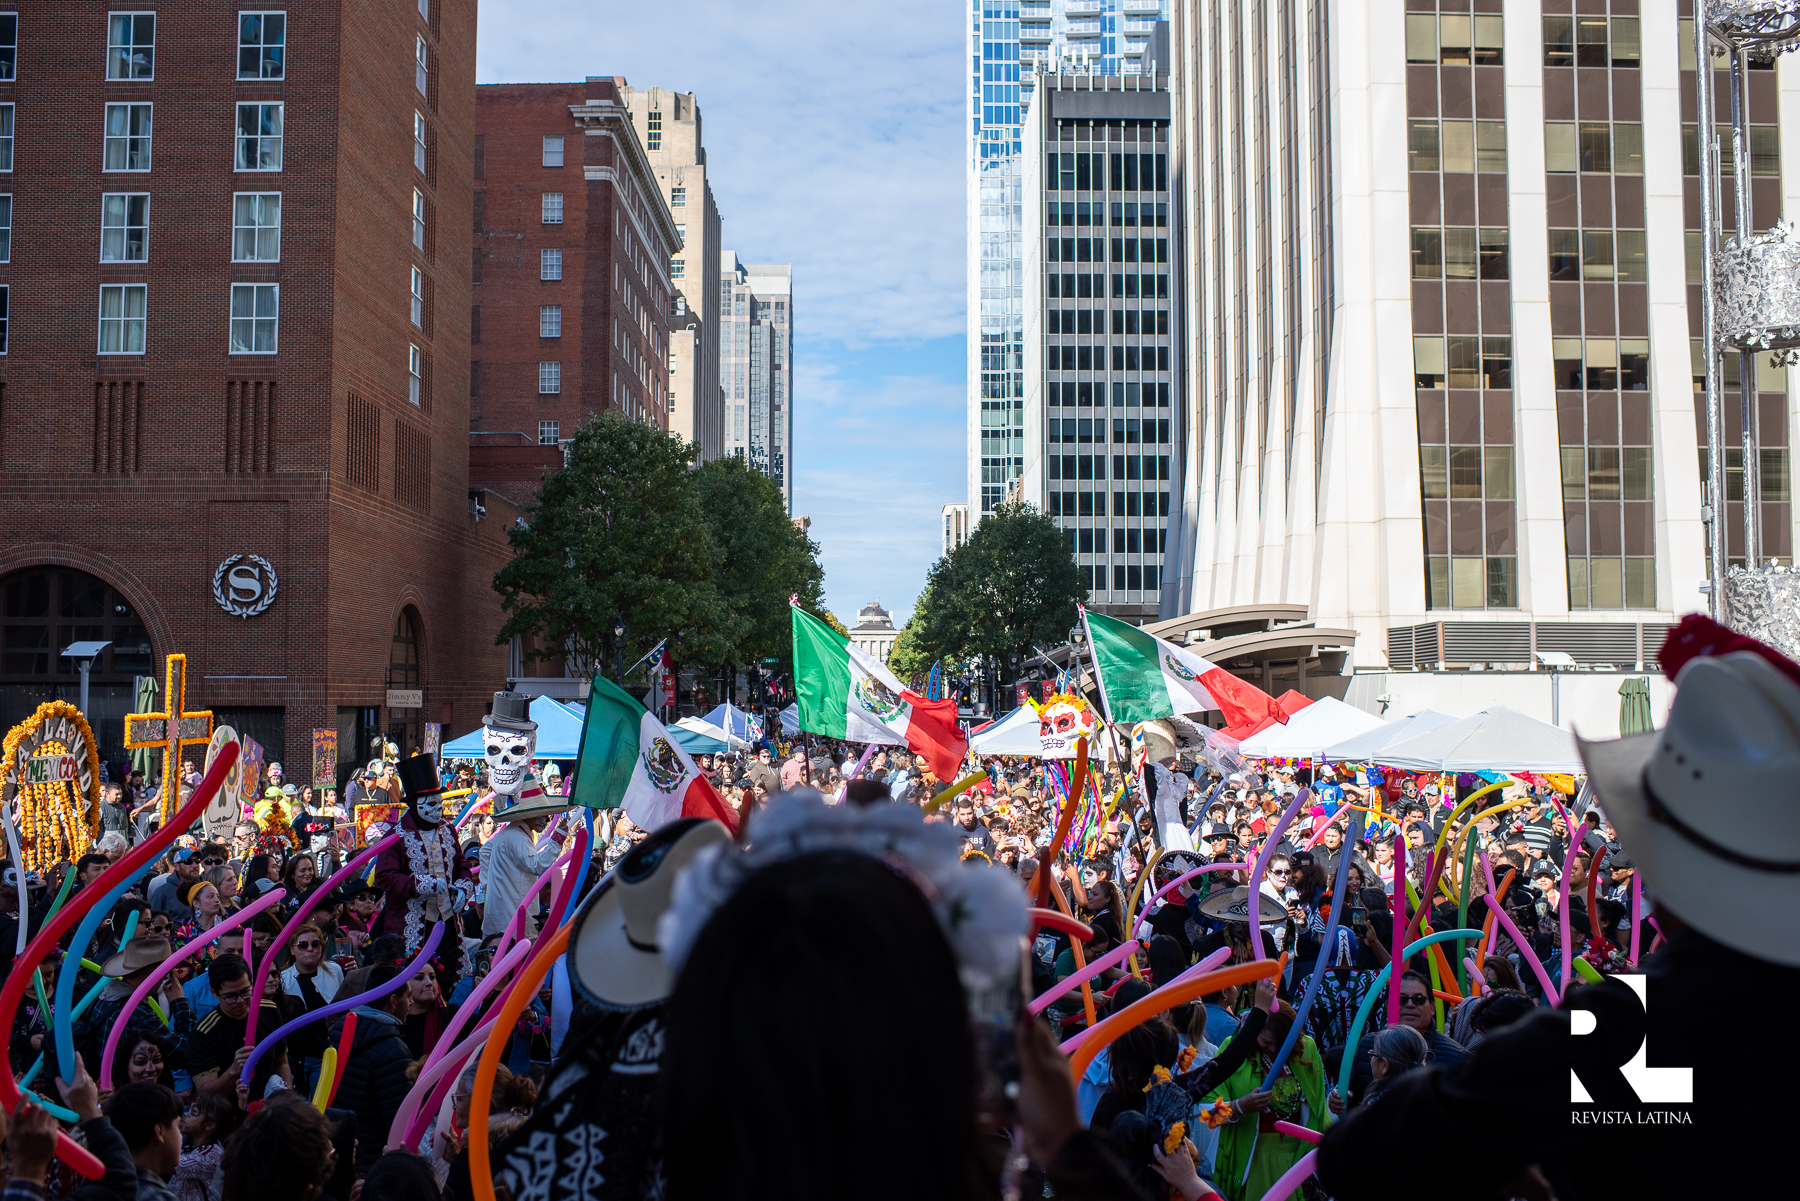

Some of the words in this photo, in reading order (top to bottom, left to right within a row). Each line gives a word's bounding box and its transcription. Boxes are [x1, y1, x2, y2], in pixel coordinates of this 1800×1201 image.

[229, 566, 262, 602] S
[930, 663, 940, 701] SLUSHI
[44, 717, 67, 742] LA
[28, 757, 76, 782] MEXICO
